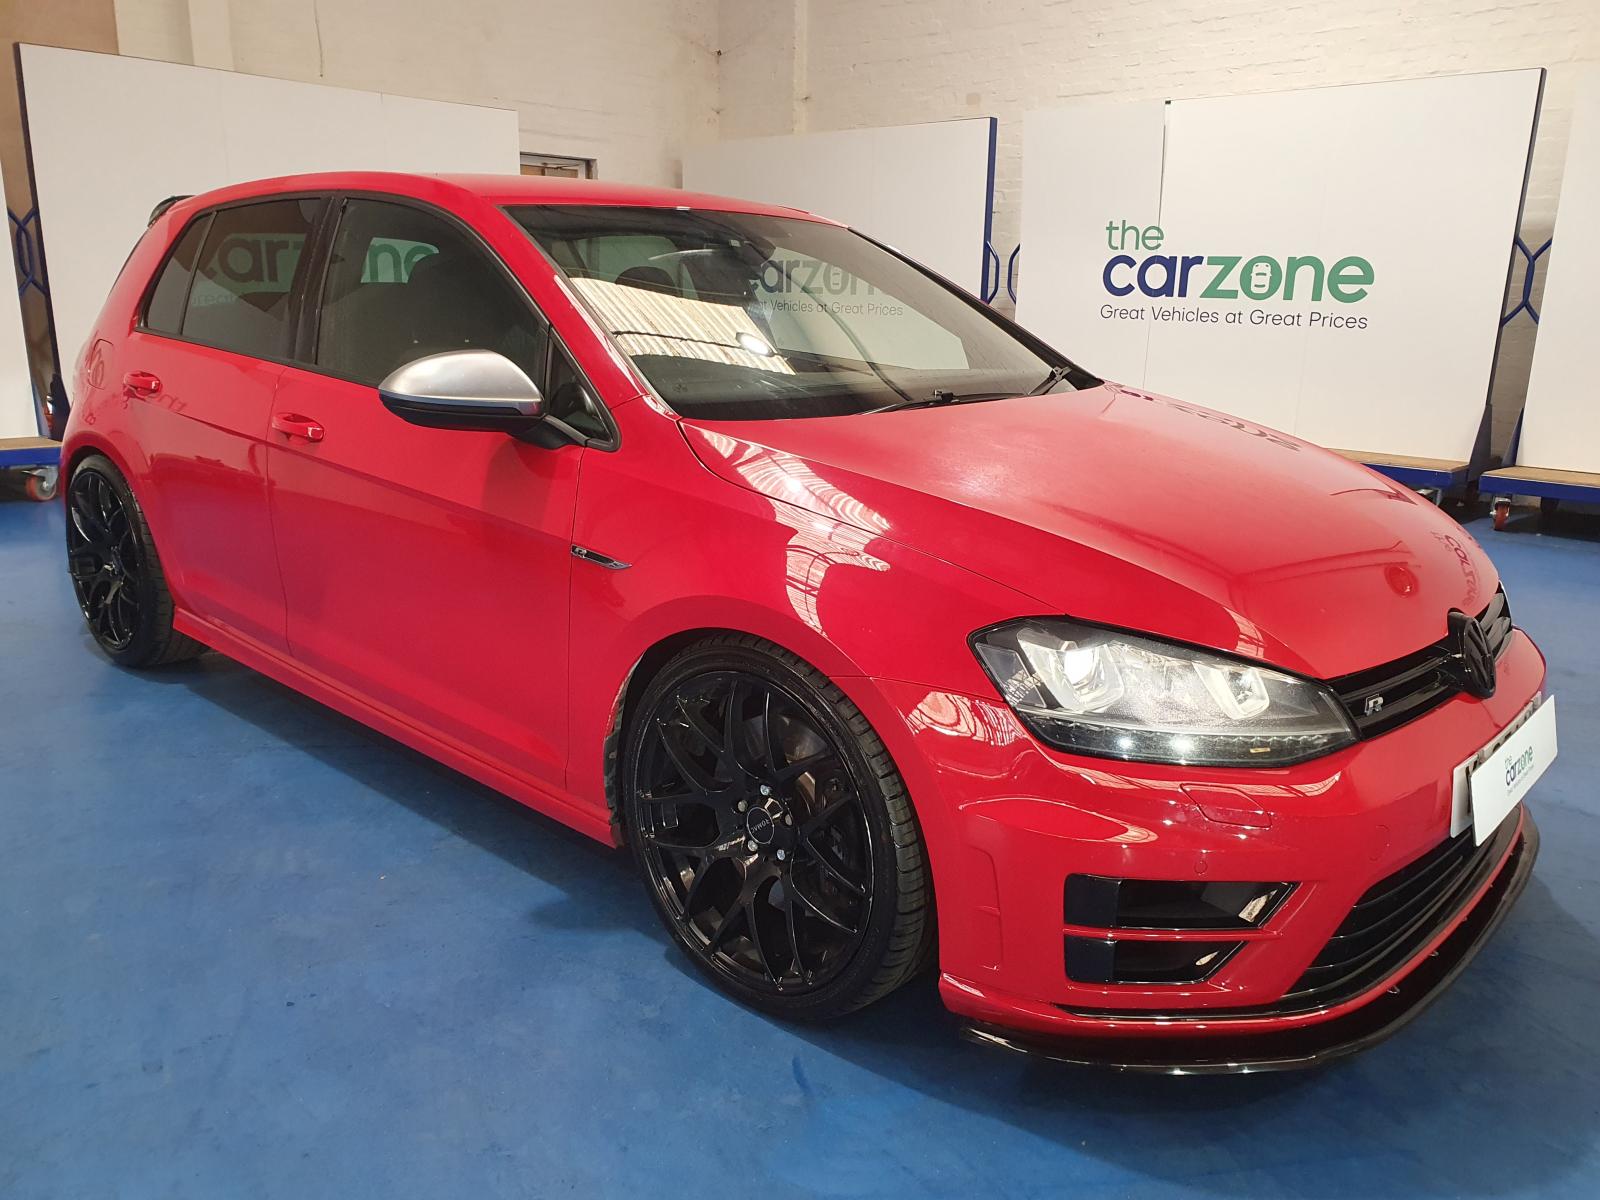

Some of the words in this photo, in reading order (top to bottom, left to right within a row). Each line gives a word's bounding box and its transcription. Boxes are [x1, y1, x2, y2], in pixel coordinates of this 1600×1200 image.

[1105, 220, 1165, 251] the
[1102, 254, 1375, 304] carzone
[831, 302, 865, 315] Great
[867, 304, 904, 317] Prices
[1100, 304, 1145, 321] Great
[1151, 305, 1219, 324] Vehicles
[1225, 309, 1243, 325] at
[1249, 309, 1302, 328] Great
[1308, 311, 1368, 330] Prices
[1364, 693, 1384, 717] R
